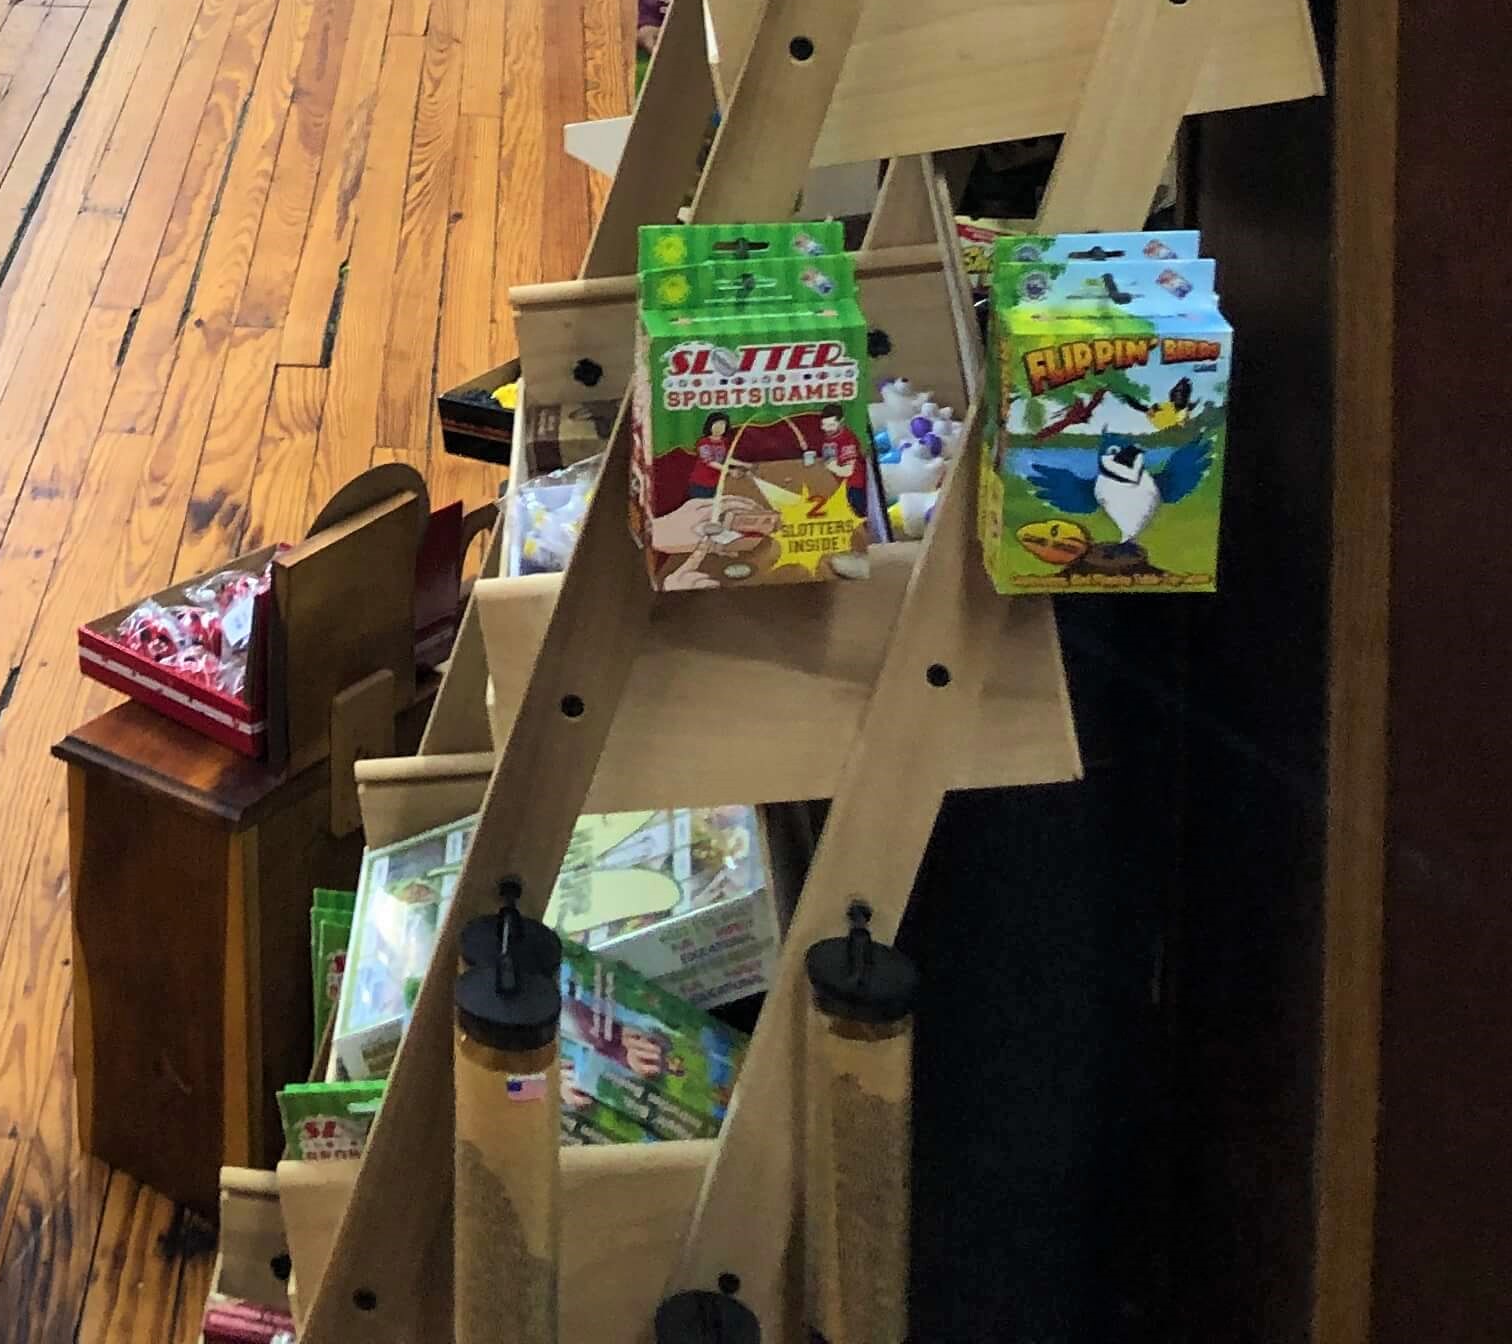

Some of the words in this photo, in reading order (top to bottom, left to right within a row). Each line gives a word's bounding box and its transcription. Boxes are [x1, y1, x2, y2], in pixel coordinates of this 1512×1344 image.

[1024, 337, 1158, 396] FLIPPIN'
[667, 387, 762, 408] SPORTS
[771, 381, 855, 403] GAMES
[807, 495, 829, 518] 2
[781, 518, 855, 538] SLOTTERS
[787, 535, 847, 553] INSIDE!
